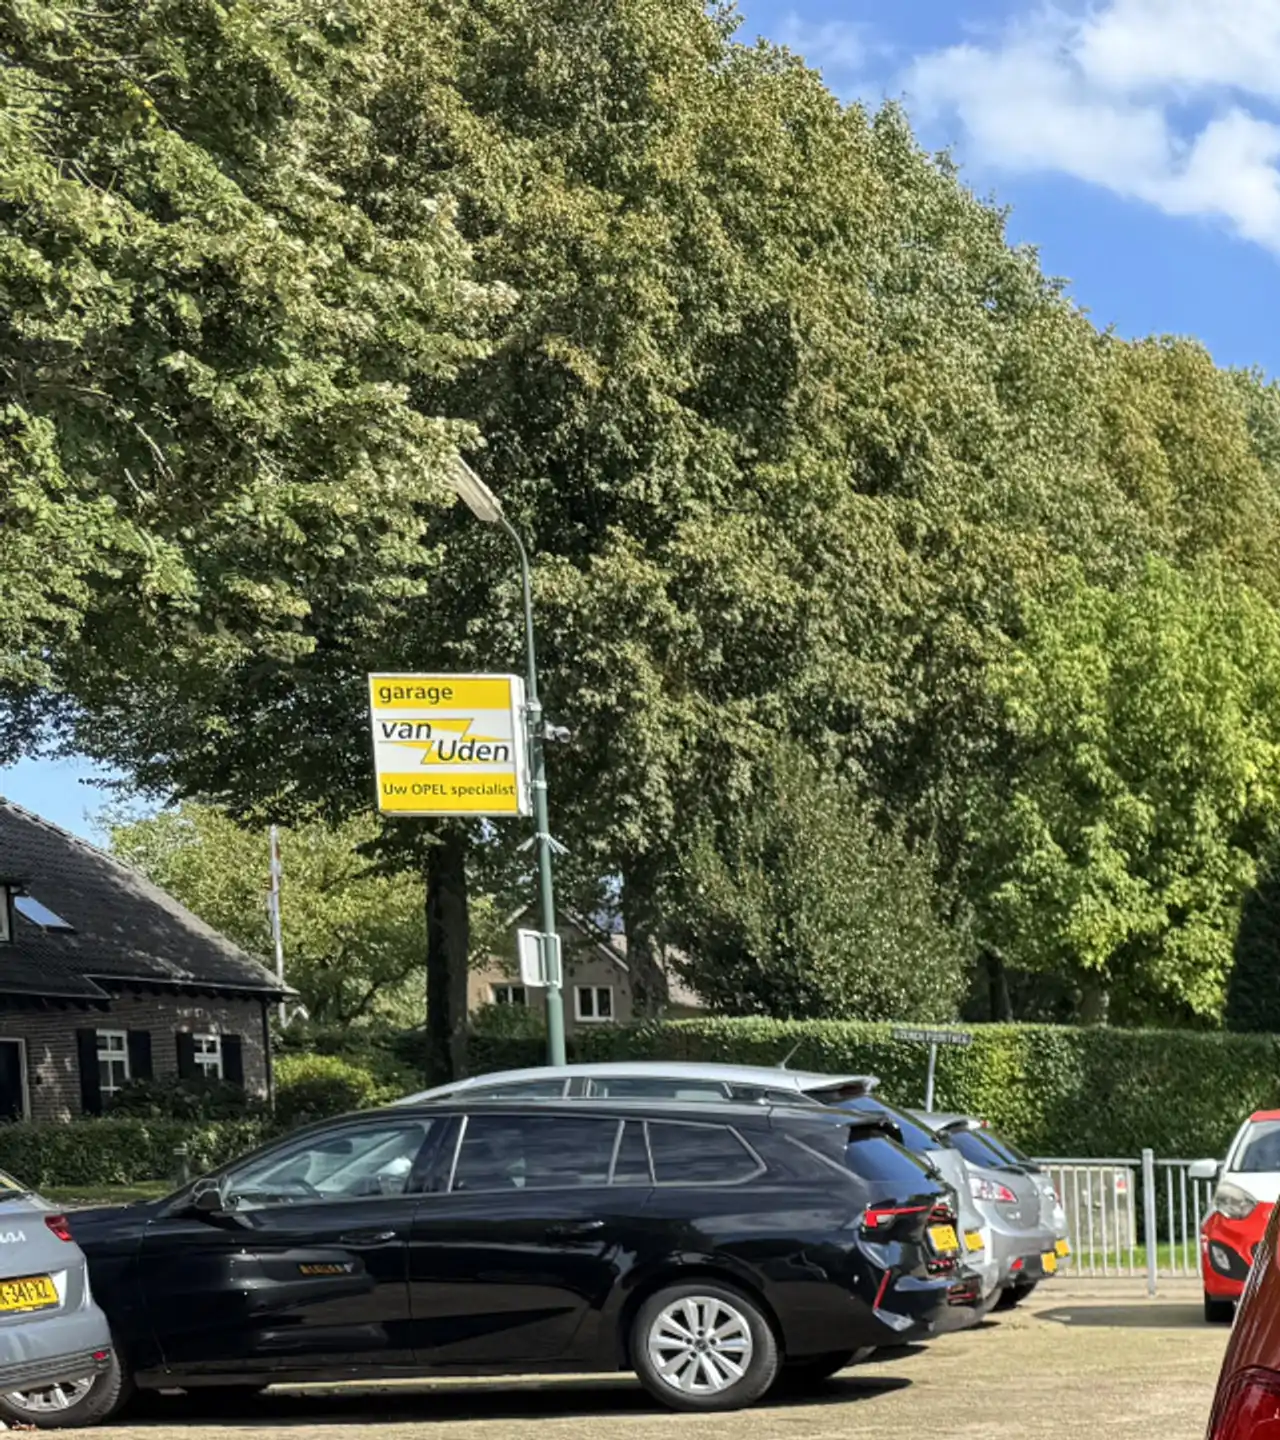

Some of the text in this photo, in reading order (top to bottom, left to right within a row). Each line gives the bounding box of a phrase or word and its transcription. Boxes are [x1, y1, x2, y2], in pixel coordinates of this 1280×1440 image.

[379, 685, 453, 704] garage
[382, 721, 509, 762] van Uden
[383, 782, 516, 798] Uw OPEL specialist
